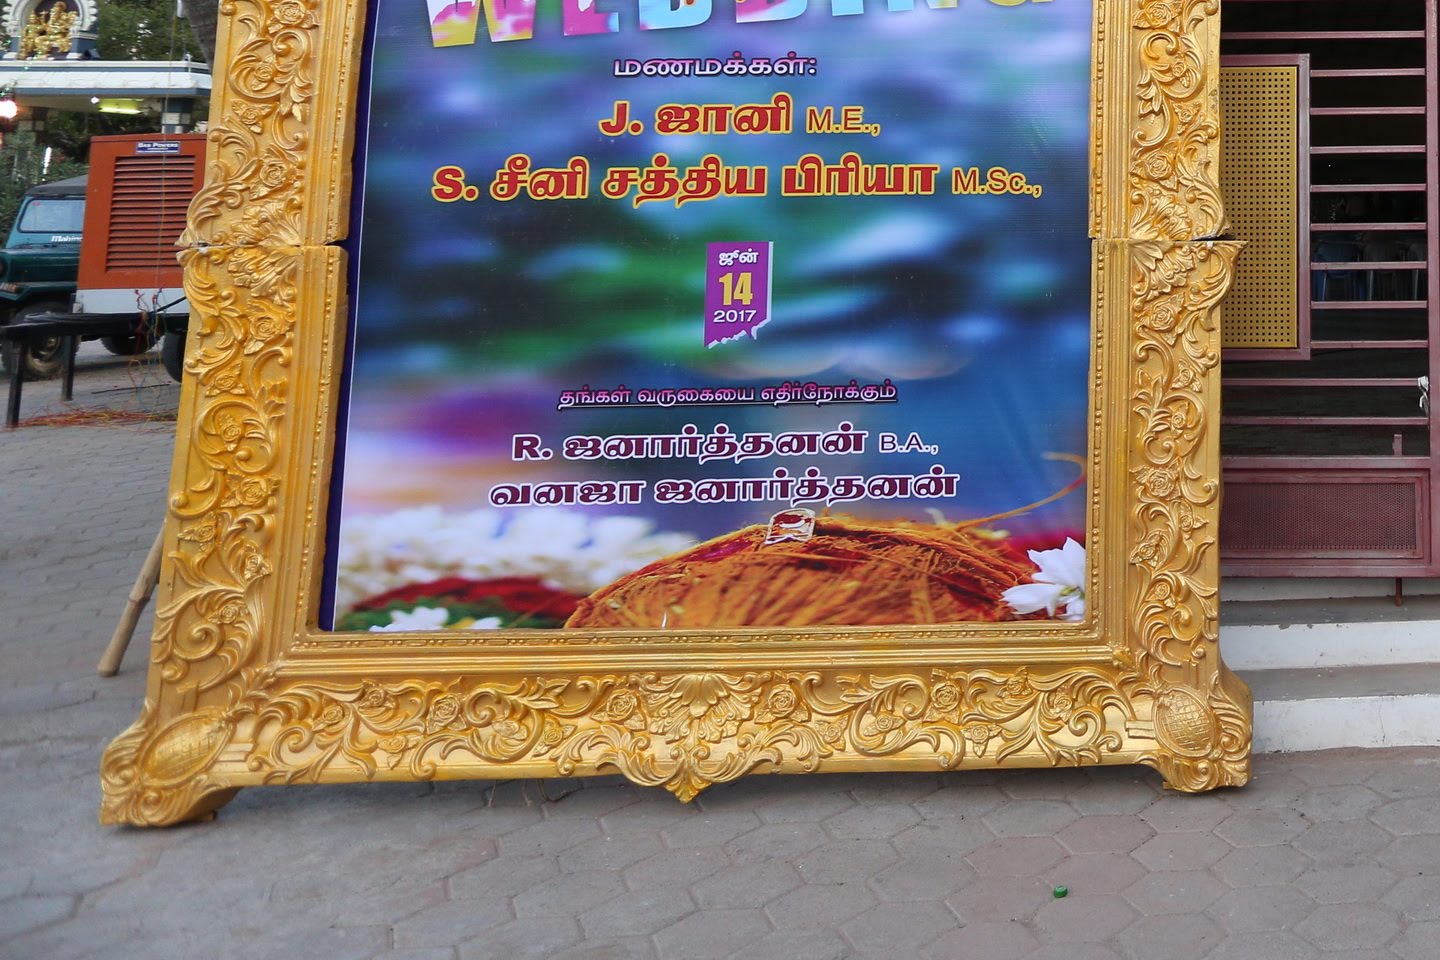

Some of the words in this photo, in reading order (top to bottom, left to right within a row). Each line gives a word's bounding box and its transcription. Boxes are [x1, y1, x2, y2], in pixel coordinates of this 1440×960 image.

[613, 51, 818, 77] மணமக்கள்:
[598, 100, 642, 137] J.
[655, 92, 793, 136] ஜானி
[807, 106, 881, 137] M.E.,
[430, 165, 479, 202] S.
[489, 153, 590, 203] சீனி
[599, 153, 768, 209] சத்திய
[780, 154, 940, 198] பிரியா
[952, 168, 1042, 199] M.Sc.,
[719, 248, 759, 266] ஜூன்
[718, 272, 753, 306] 14
[713, 309, 757, 323] 2017
[557, 384, 632, 410] தங்கள்
[637, 387, 755, 408] வருகையை
[760, 379, 897, 406] எதிர்நோக்கும்
[512, 433, 552, 461] R.
[563, 421, 869, 466] ஜனார்த்தனன்
[878, 432, 939, 456] B.A.,
[489, 474, 646, 508] வனஜா
[654, 465, 960, 508] ஜனார்த்தனன்
